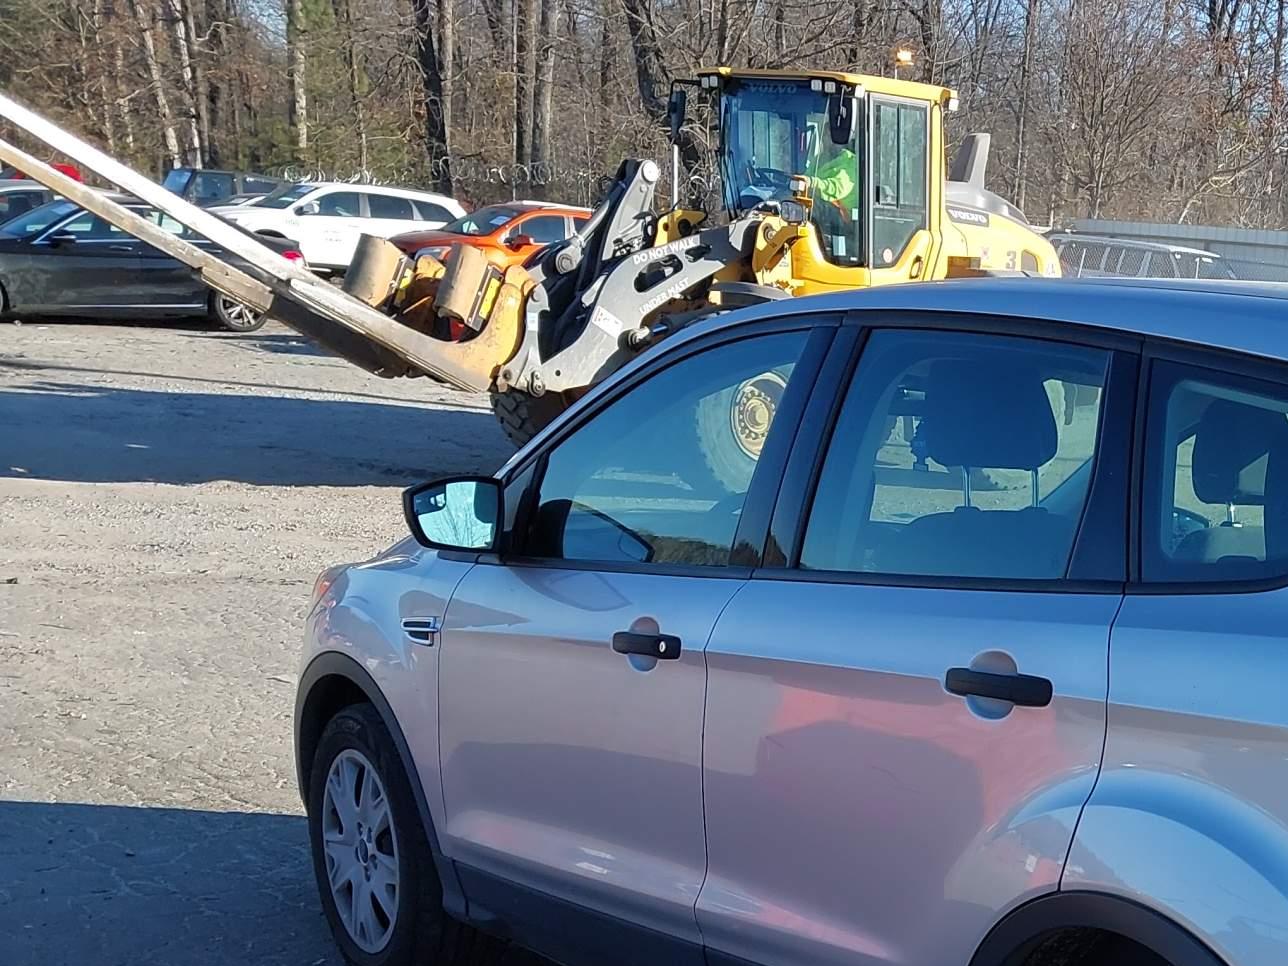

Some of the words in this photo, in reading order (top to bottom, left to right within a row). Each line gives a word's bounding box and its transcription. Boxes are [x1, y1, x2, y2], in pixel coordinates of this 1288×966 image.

[749, 84, 798, 95] VOLVO
[947, 209, 988, 224] VOLVO
[632, 252, 649, 265] DO
[649, 246, 669, 260] NOT
[670, 238, 695, 253] WALK
[1005, 250, 1017, 269] 3
[639, 293, 669, 314] UNDER
[667, 277, 690, 298] MAST
